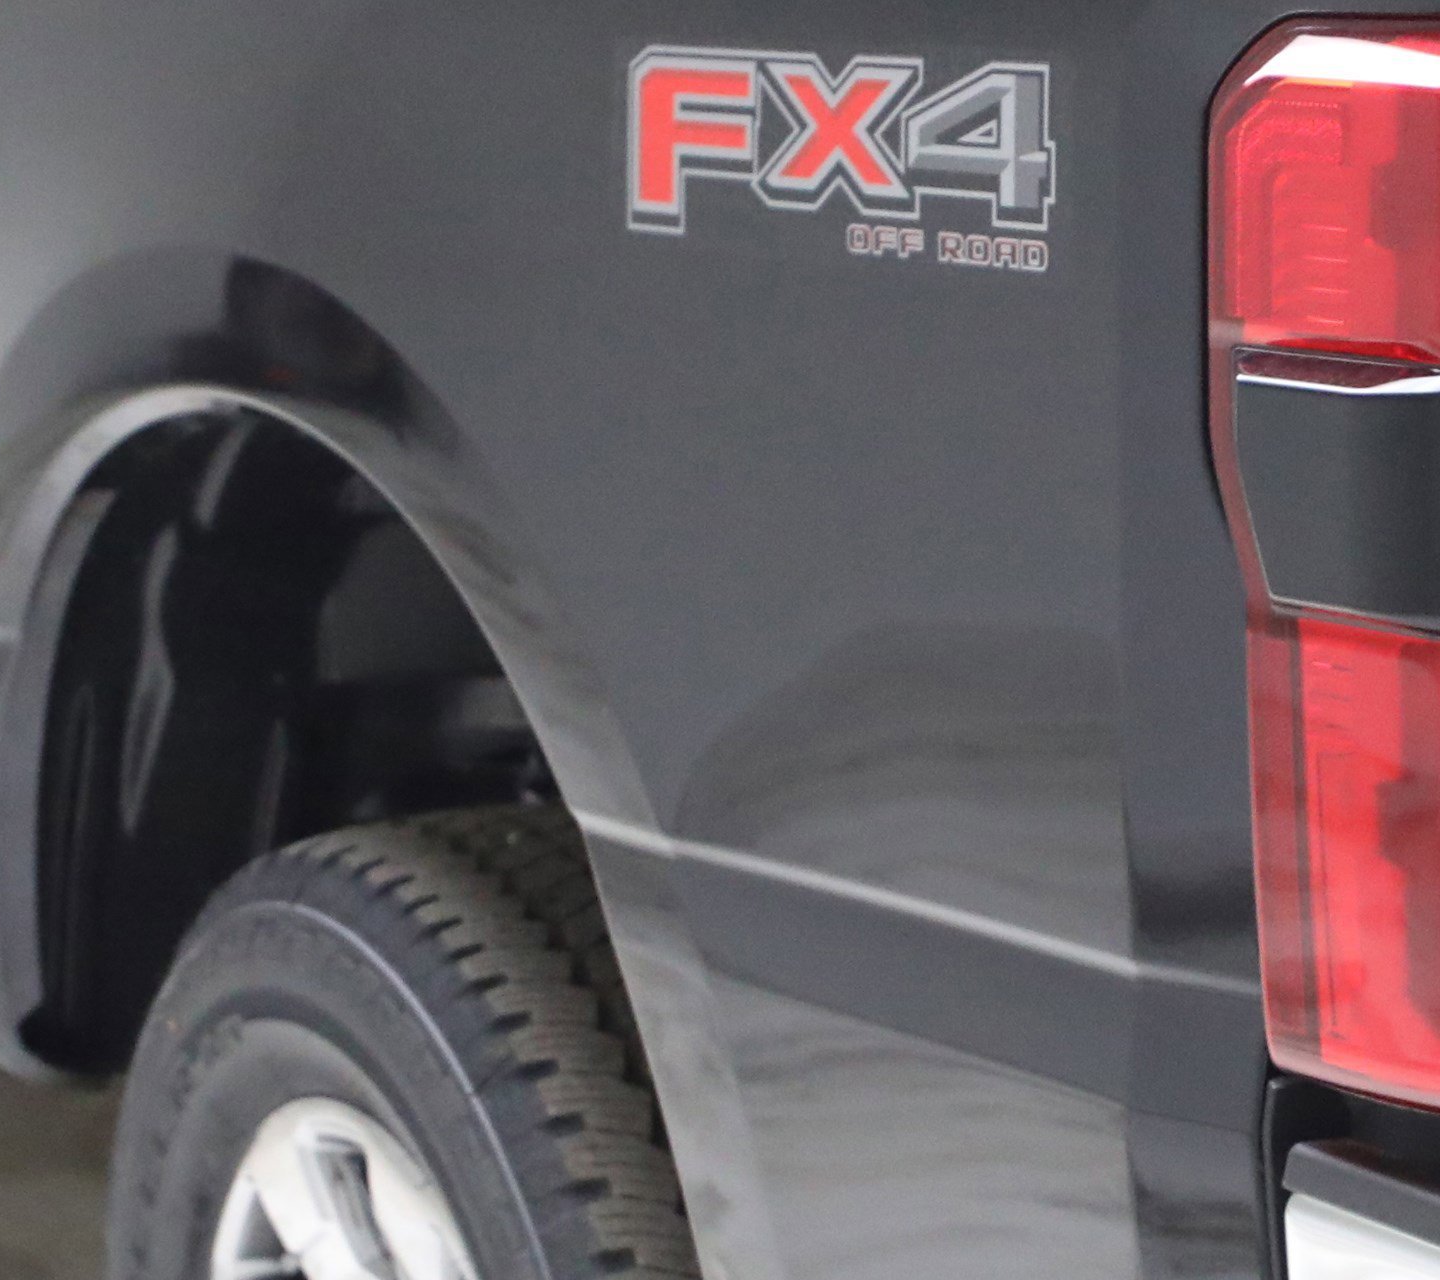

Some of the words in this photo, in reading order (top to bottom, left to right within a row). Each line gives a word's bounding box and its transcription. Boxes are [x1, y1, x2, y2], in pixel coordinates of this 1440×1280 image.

[627, 44, 1056, 235] FX4
[847, 223, 924, 258] OFF
[938, 233, 1049, 272] ROAD
